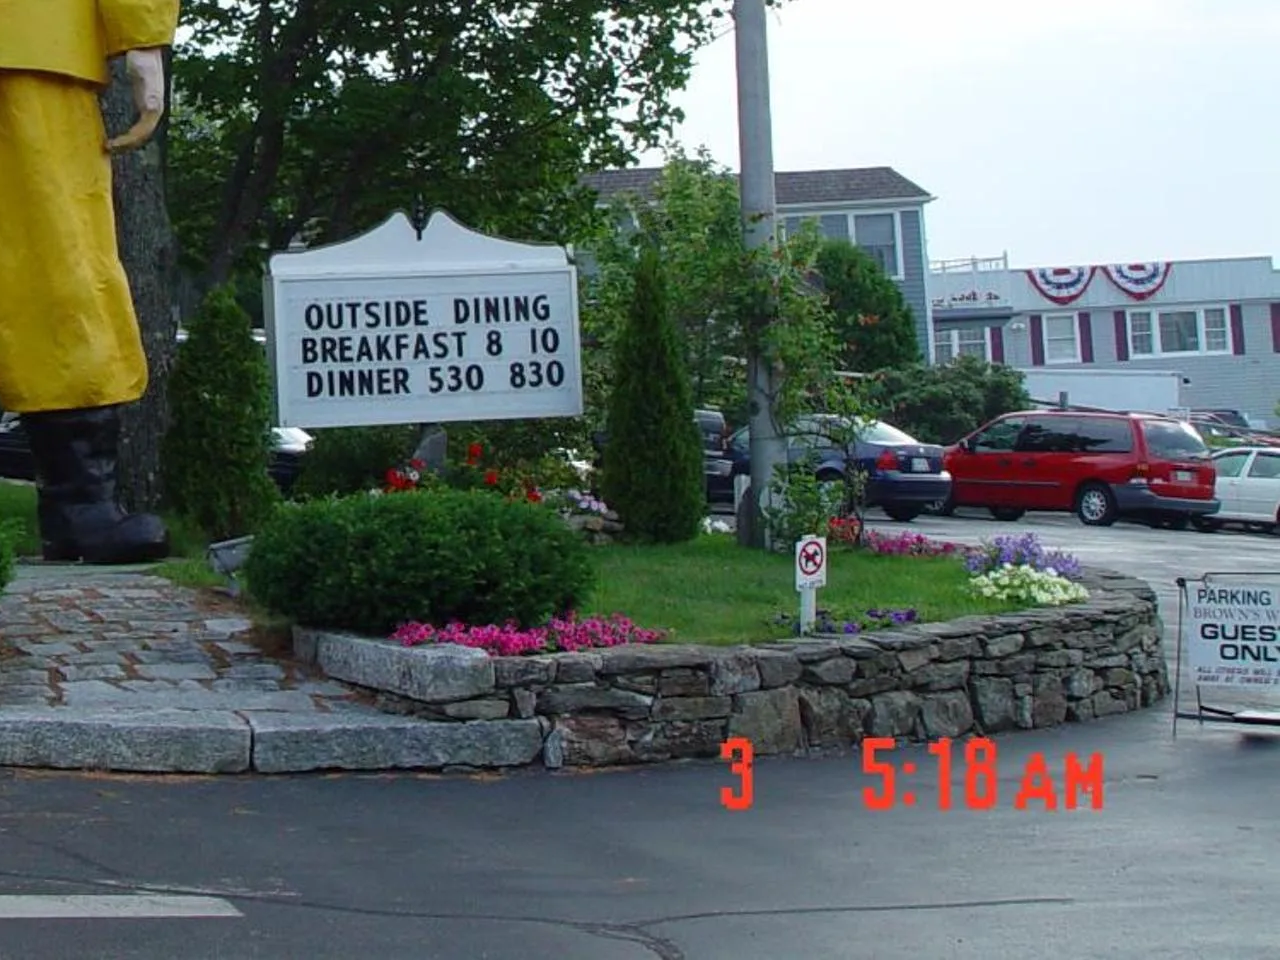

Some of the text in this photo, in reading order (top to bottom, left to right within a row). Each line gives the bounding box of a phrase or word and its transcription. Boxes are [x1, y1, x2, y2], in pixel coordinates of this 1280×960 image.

[304, 295, 551, 331] OUTSIDE DINING
[302, 327, 560, 365] BREAKFAST 8 10
[306, 360, 565, 398] DINNER 530 830
[1193, 606, 1261, 621] BROWN'S
[1197, 589, 1272, 606] PARKING
